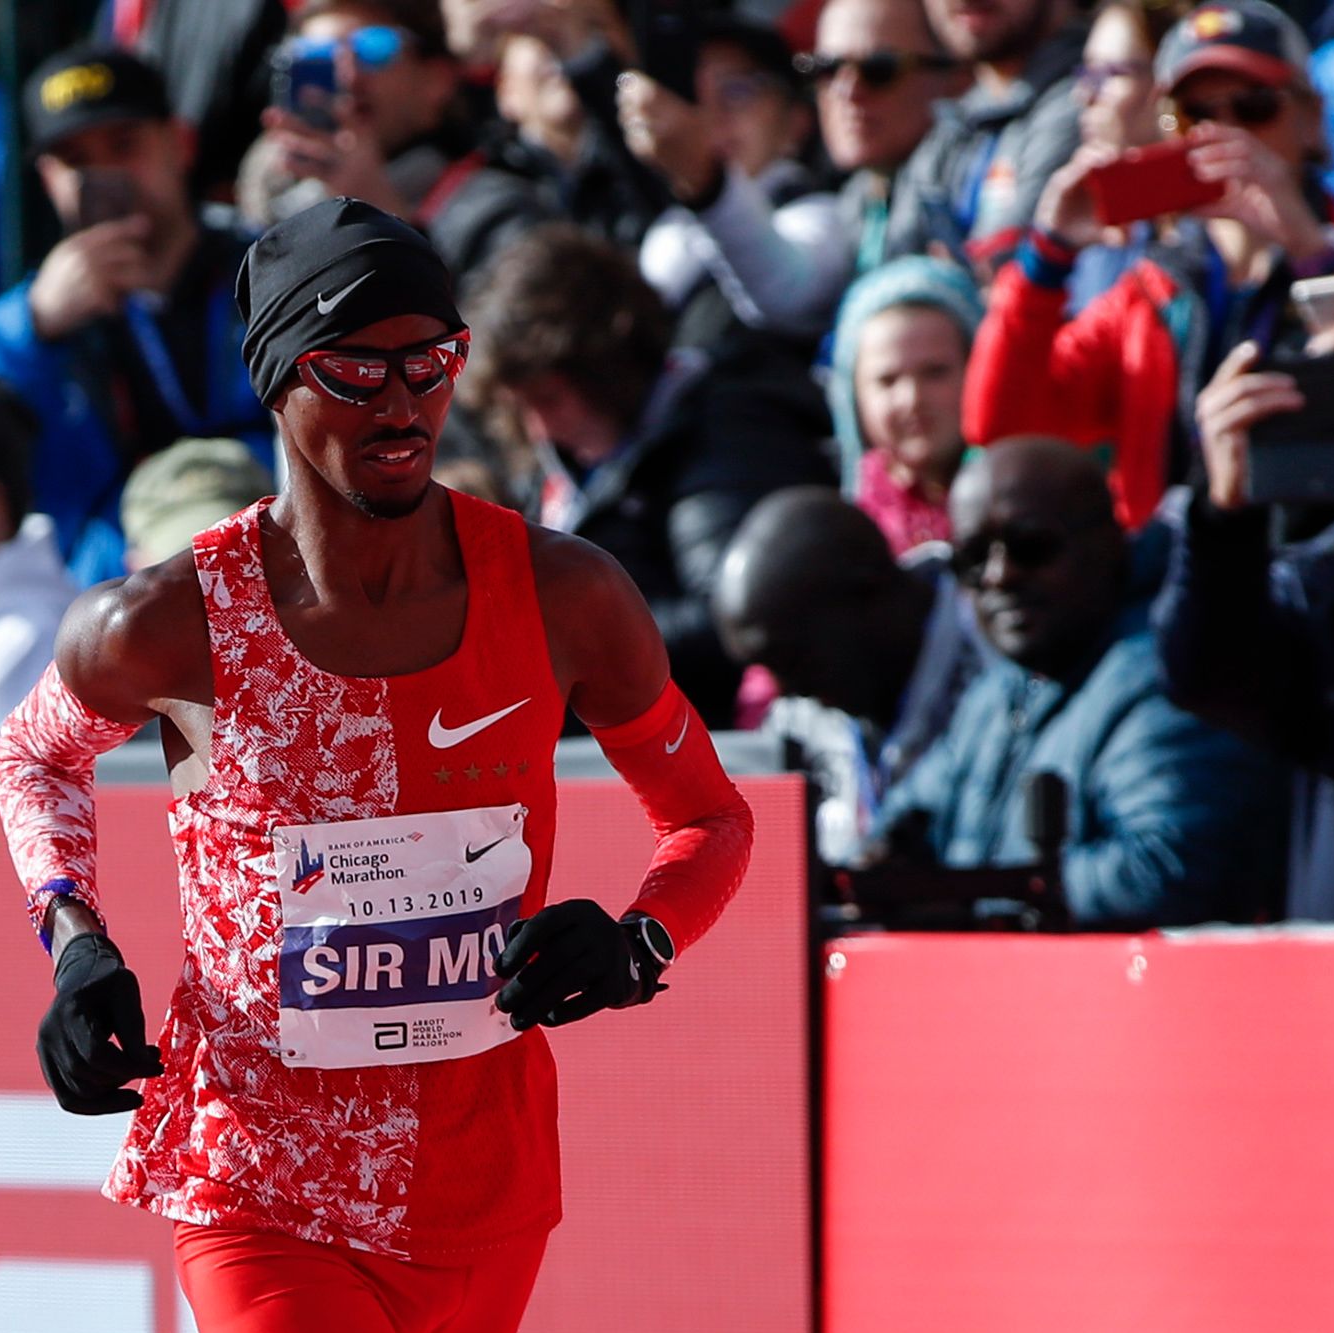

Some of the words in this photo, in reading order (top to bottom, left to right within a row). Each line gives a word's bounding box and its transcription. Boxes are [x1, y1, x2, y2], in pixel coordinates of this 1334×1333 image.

[328, 842, 352, 851] BANK
[366, 837, 406, 847] AMERICA
[329, 852, 389, 869] Chicago
[331, 867, 405, 885] Marathon
[348, 887, 484, 917] 10.13.2019
[301, 942, 405, 996] SIR
[412, 1018, 445, 1026] ABBOTT
[412, 1031, 462, 1040] MARATHON
[412, 1039, 448, 1047] MAJORS
